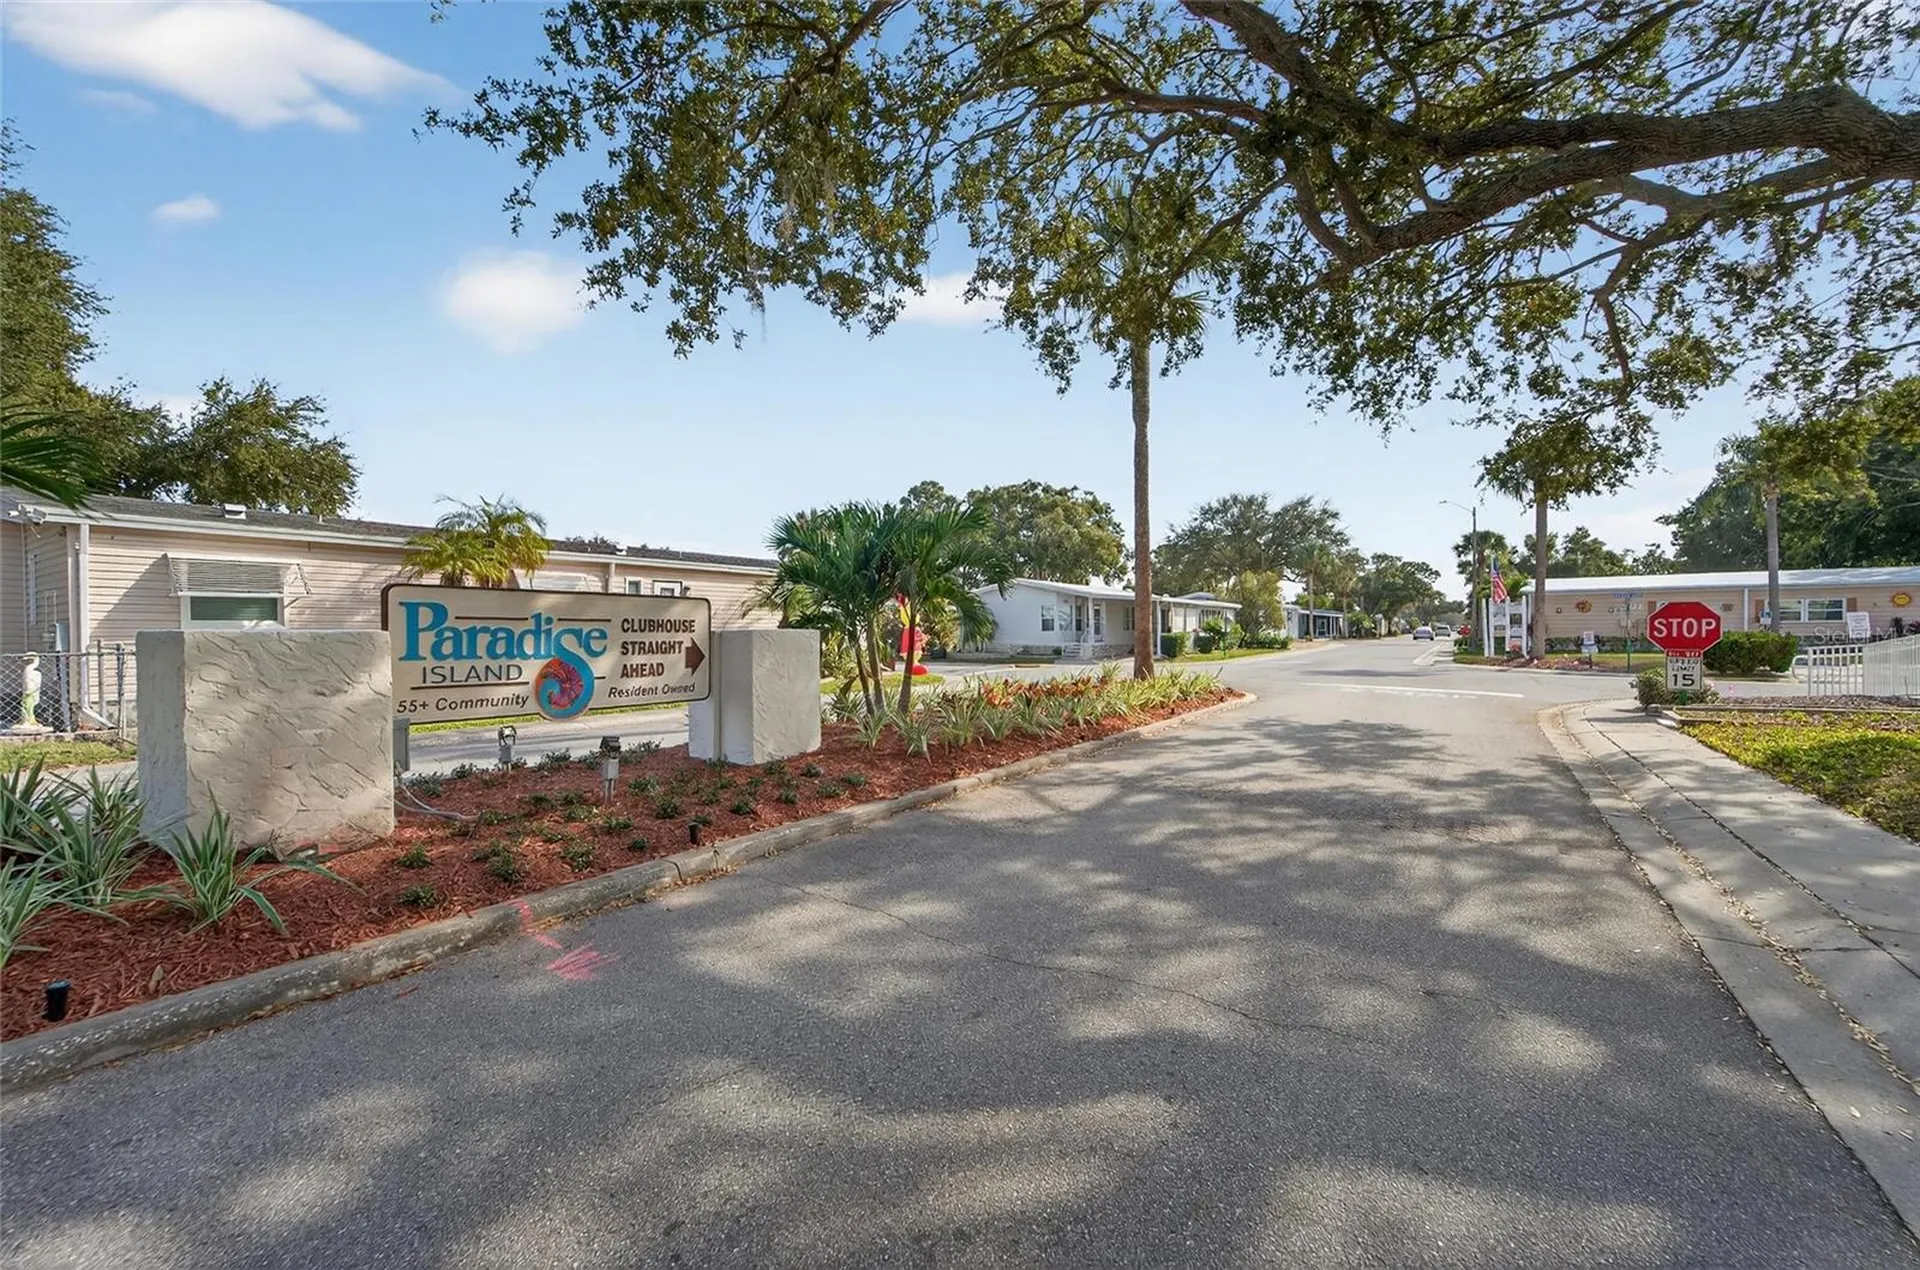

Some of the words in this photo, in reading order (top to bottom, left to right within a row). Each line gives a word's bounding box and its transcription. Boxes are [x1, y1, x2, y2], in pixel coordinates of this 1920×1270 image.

[621, 618, 696, 634] CLUBHOUSE
[1653, 618, 1716, 638] STOP
[621, 641, 684, 656] STRAIGHT
[398, 601, 608, 718] Paradise
[422, 664, 523, 684] ISLAND
[620, 662, 665, 679] AHEAD
[1672, 673, 1695, 687] 15
[608, 686, 658, 698] Resident
[661, 681, 696, 695] Owned
[396, 700, 429, 713] 55+
[435, 693, 529, 711] Community
